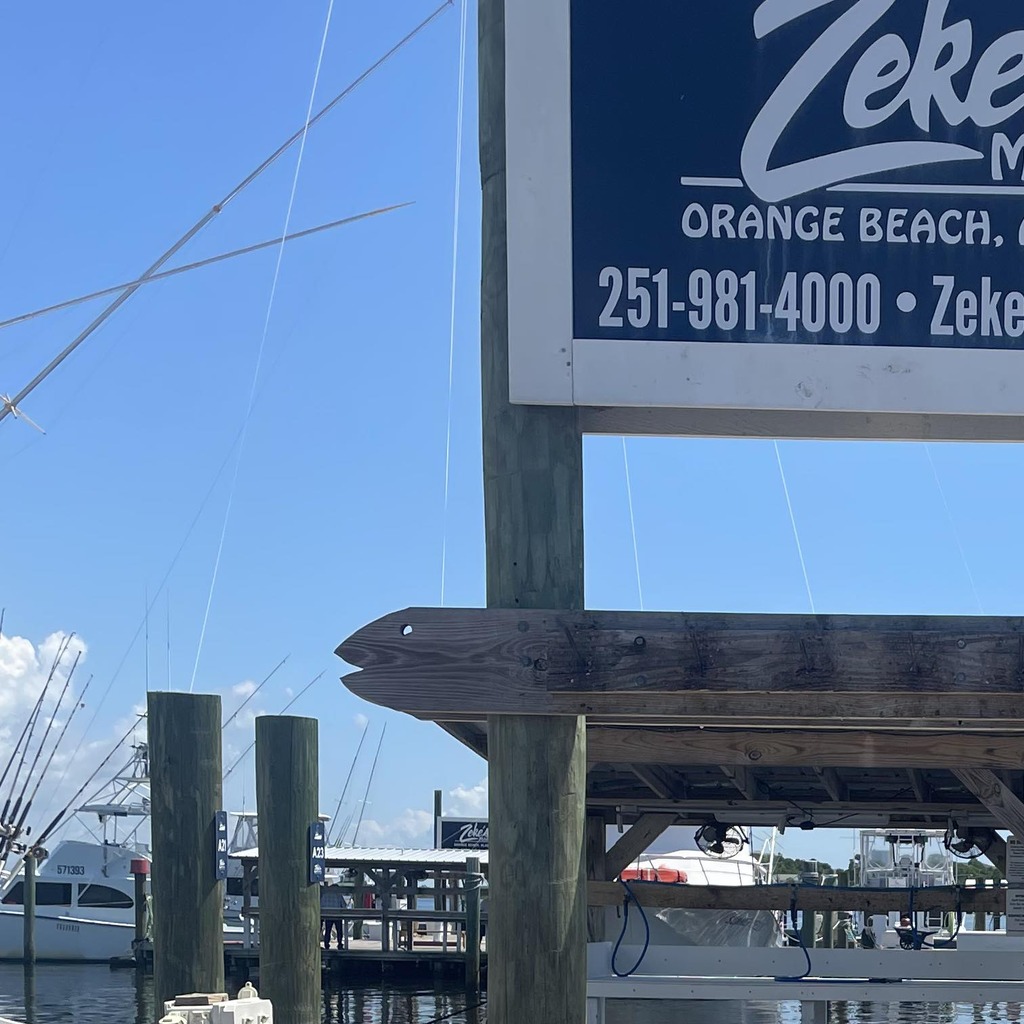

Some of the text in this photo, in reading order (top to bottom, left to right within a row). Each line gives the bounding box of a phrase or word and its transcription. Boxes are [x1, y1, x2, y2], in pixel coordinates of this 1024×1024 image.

[681, 202, 845, 241] ORANGE
[859, 207, 1004, 247] BEACH,
[598, 265, 881, 334] 251-981-4000
[312, 846, 324, 859] A23
[57, 865, 85, 876] 571393
